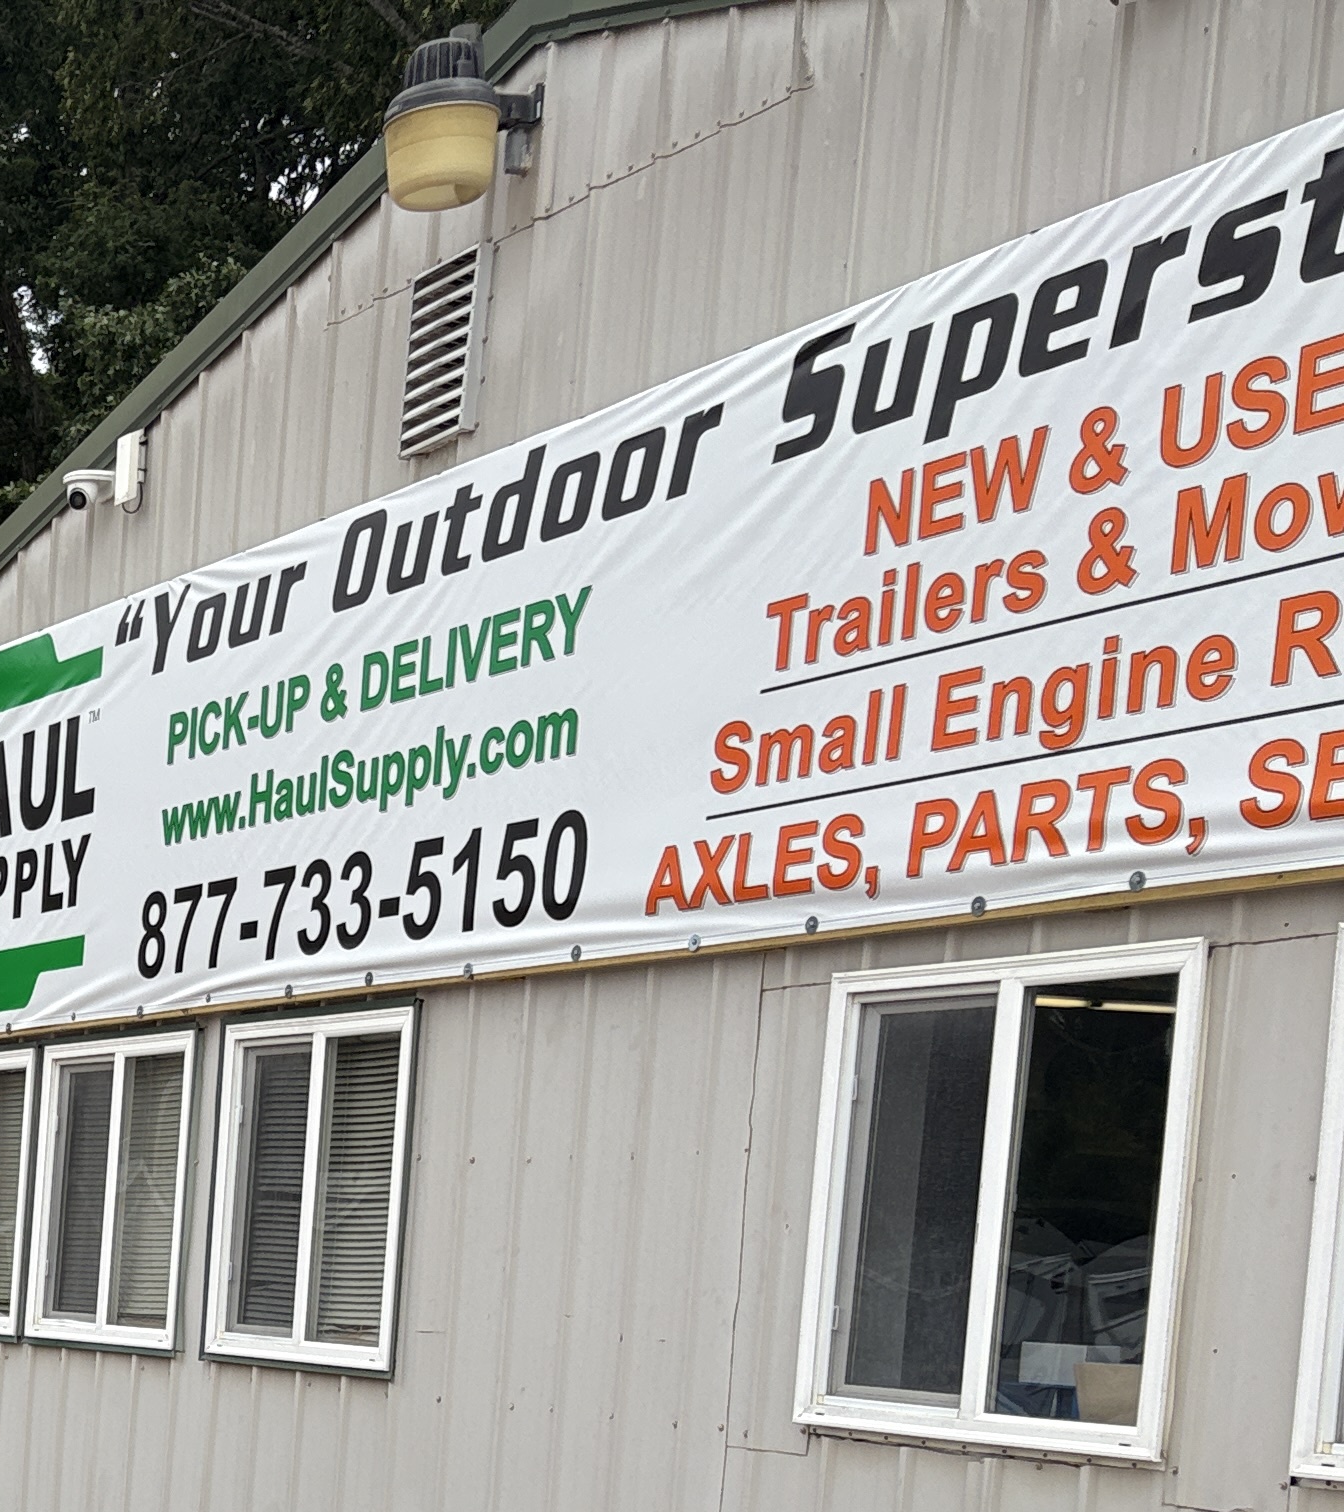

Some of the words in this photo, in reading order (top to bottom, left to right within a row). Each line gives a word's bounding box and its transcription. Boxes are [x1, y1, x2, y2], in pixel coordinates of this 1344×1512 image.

[331, 402, 725, 614] Outdoor
[771, 147, 1344, 464] Superst
[863, 425, 1050, 556] NEW
[1069, 407, 1128, 494] &
[1158, 333, 1344, 469] USE
[166, 674, 311, 765] PICK-UP
[320, 662, 348, 723] &
[360, 585, 592, 710] DELIVERY
[766, 549, 1048, 672] Trailers
[1076, 507, 1137, 596] &
[162, 707, 580, 846] www.HaulSupply.com
[710, 682, 907, 795] Small
[930, 633, 1238, 750] Engine
[1271, 590, 1342, 686] R
[138, 809, 588, 980] 877-733-5150
[644, 814, 880, 916] AXLES,
[906, 757, 1209, 878] PARTS,
